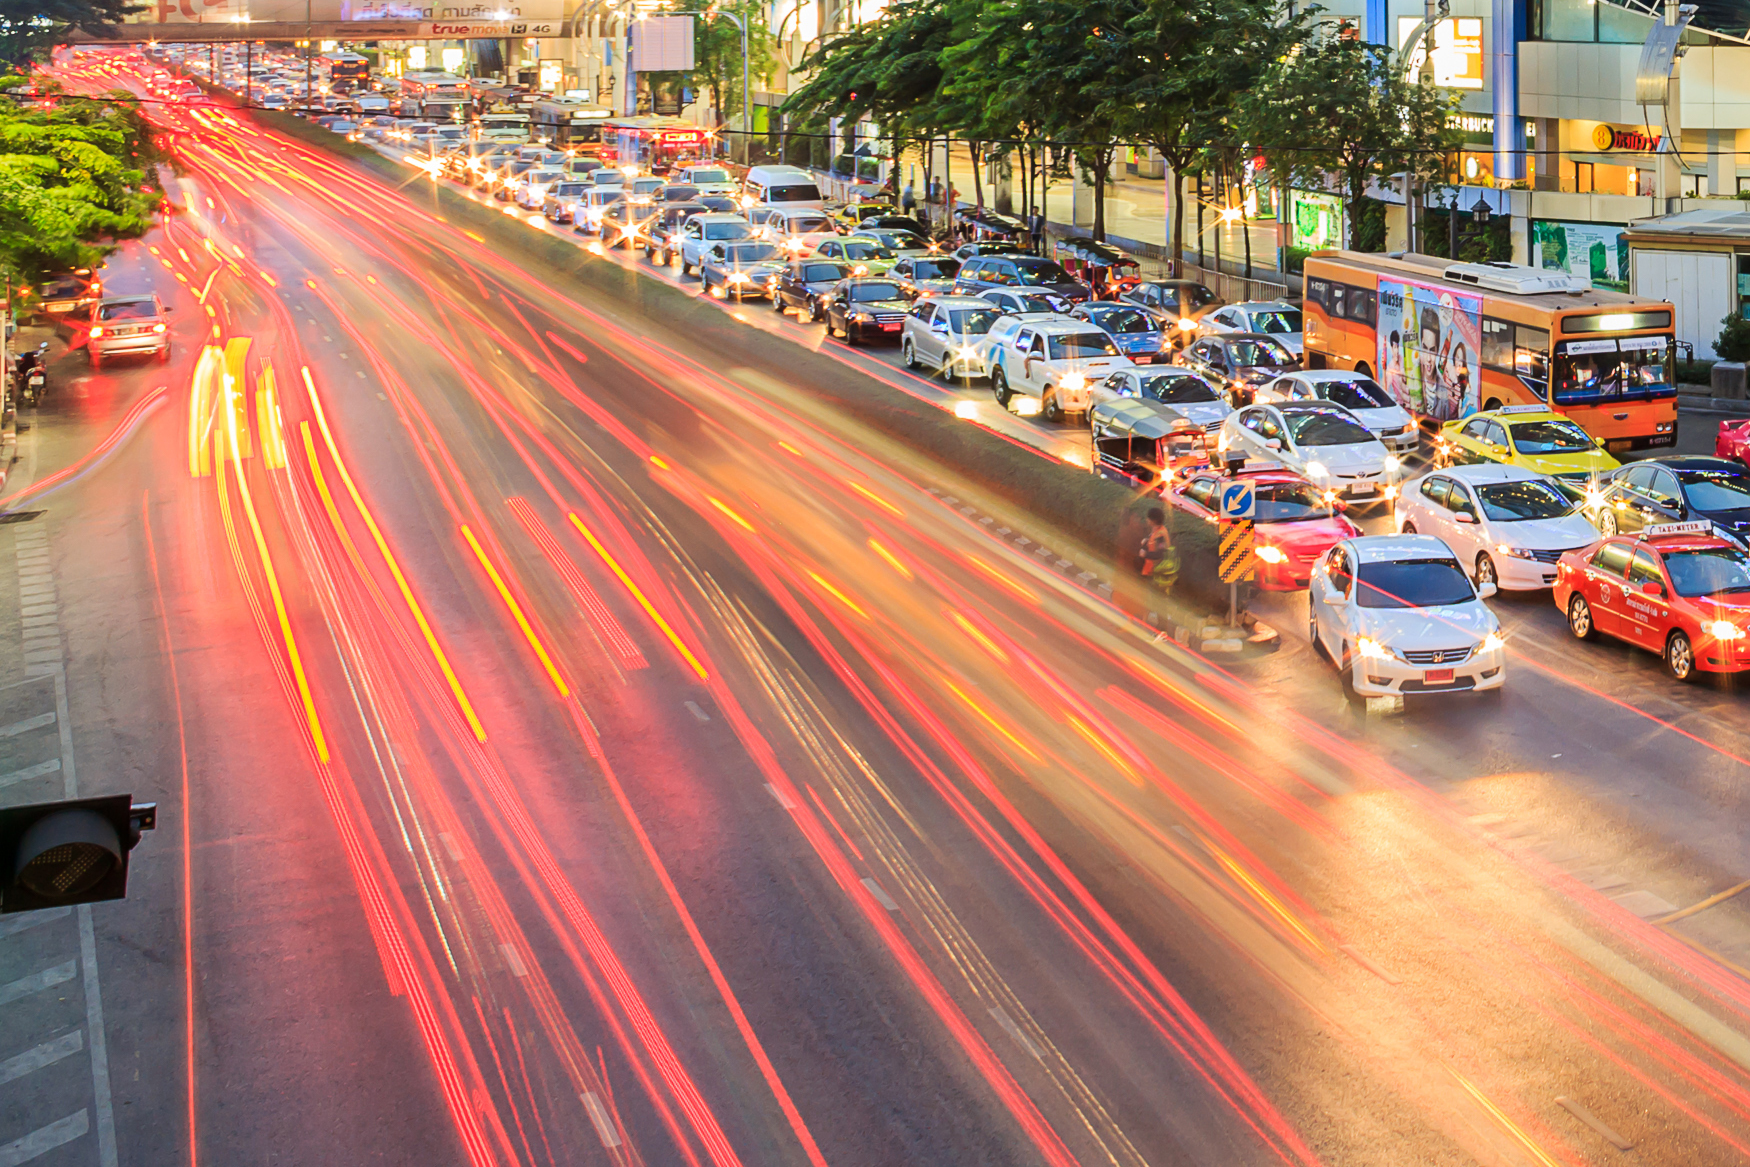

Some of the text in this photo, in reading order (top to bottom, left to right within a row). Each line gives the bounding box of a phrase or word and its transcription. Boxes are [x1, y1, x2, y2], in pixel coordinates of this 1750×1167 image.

[432, 23, 470, 34] true
[471, 24, 508, 34] move
[533, 24, 550, 33] 4G
[1658, 523, 1699, 534] TAXI-METER
